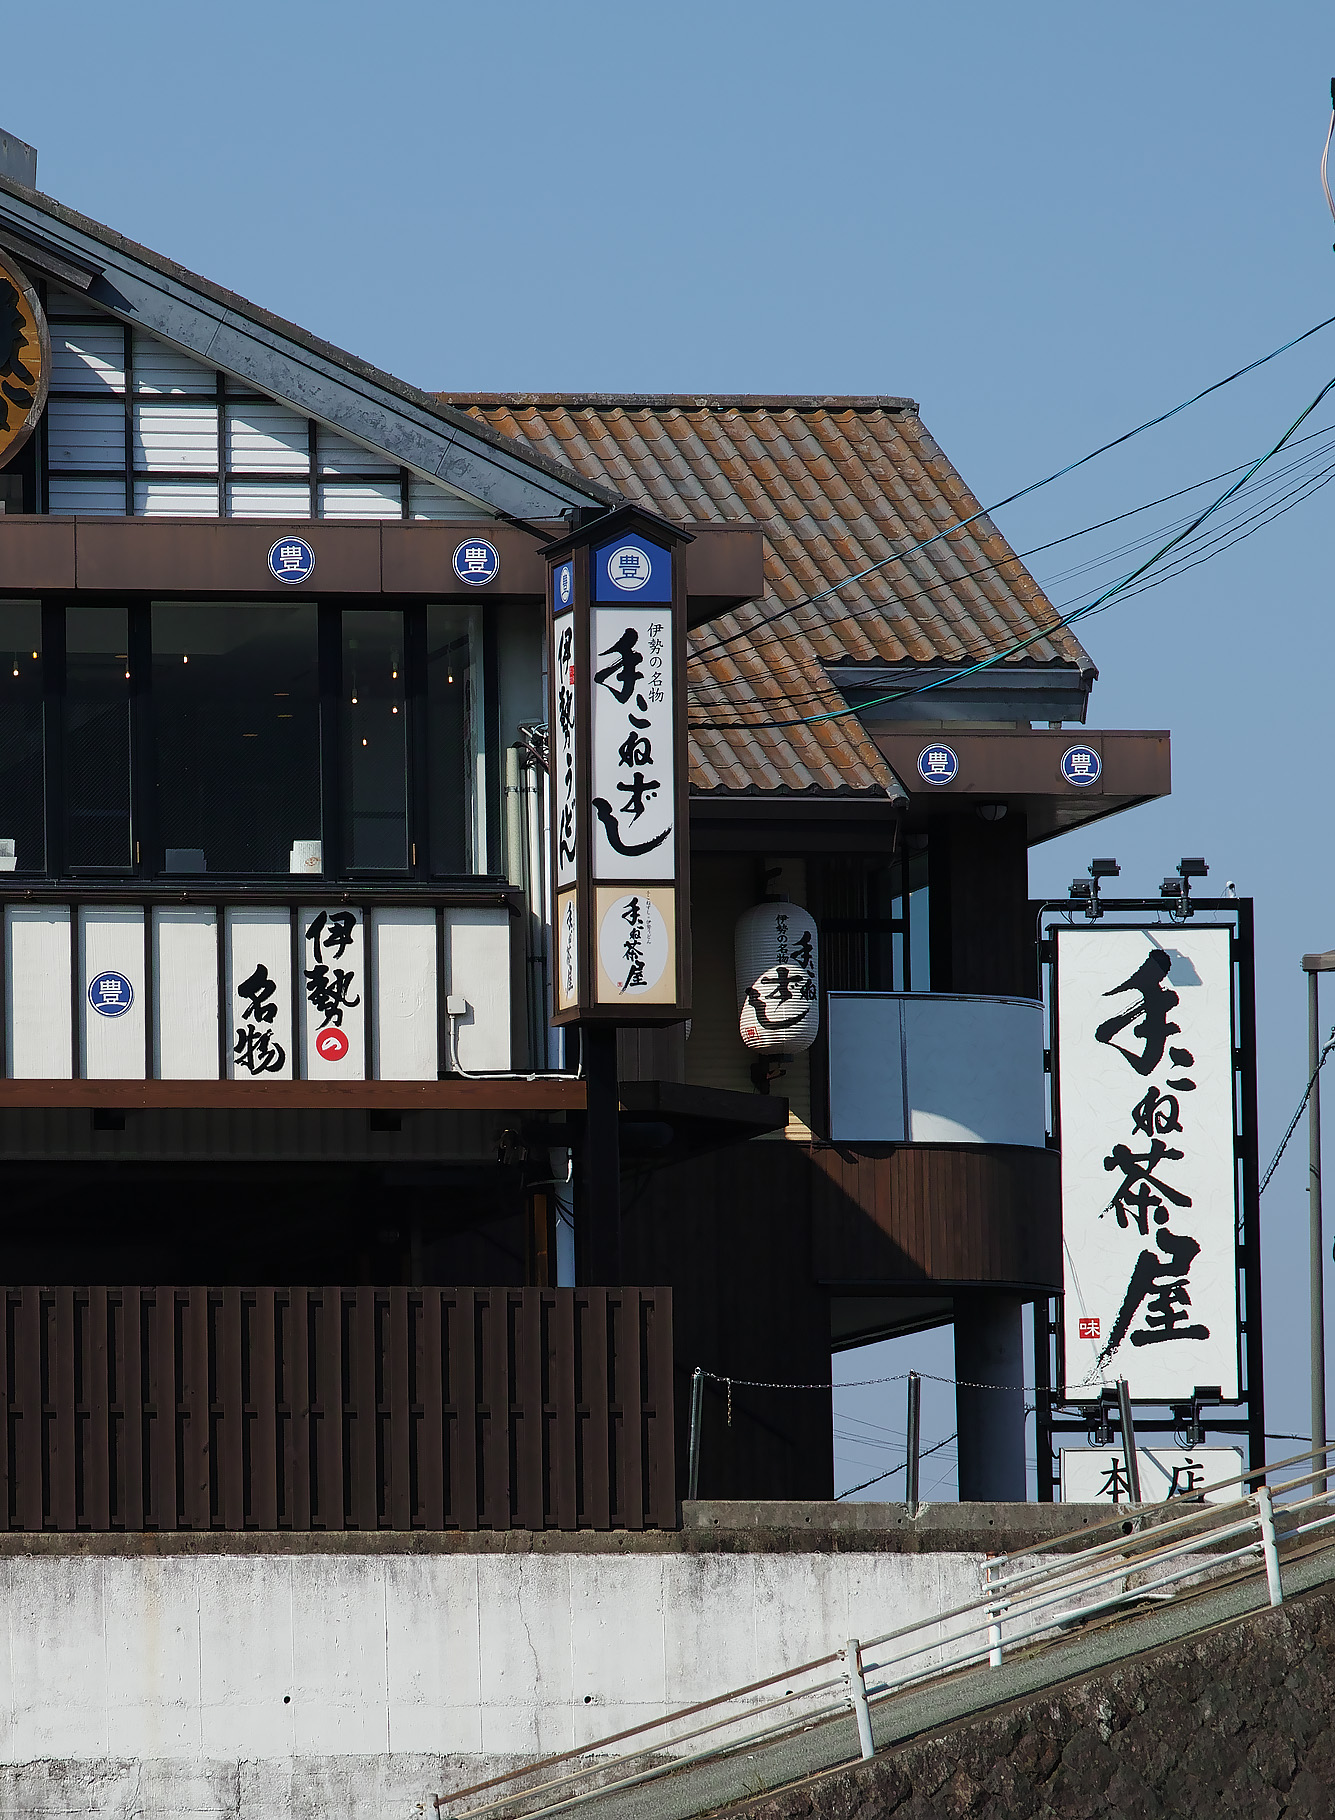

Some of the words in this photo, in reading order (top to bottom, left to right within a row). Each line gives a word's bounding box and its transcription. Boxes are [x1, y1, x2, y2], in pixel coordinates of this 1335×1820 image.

[274, 544, 310, 575] 豊
[458, 545, 495, 577] 豊
[614, 554, 647, 583] 豊
[647, 622, 665, 703] 伊勢の名物
[558, 627, 575, 871] 伊勢うどん
[592, 627, 672, 857] 手こねずし
[922, 749, 954, 777] 豊
[1066, 751, 1098, 778] 豊
[619, 897, 648, 996] 手こね茶屋
[775, 913, 789, 964] 伊勢の名物
[95, 978, 130, 1009] 豊
[745, 967, 810, 1030] ずし
[232, 963, 285, 1076] 名物
[1088, 949, 1210, 1384] 手こね茶屋
[1079, 1319, 1101, 1338] 味
[1095, 1457, 1205, 1503] 本店
